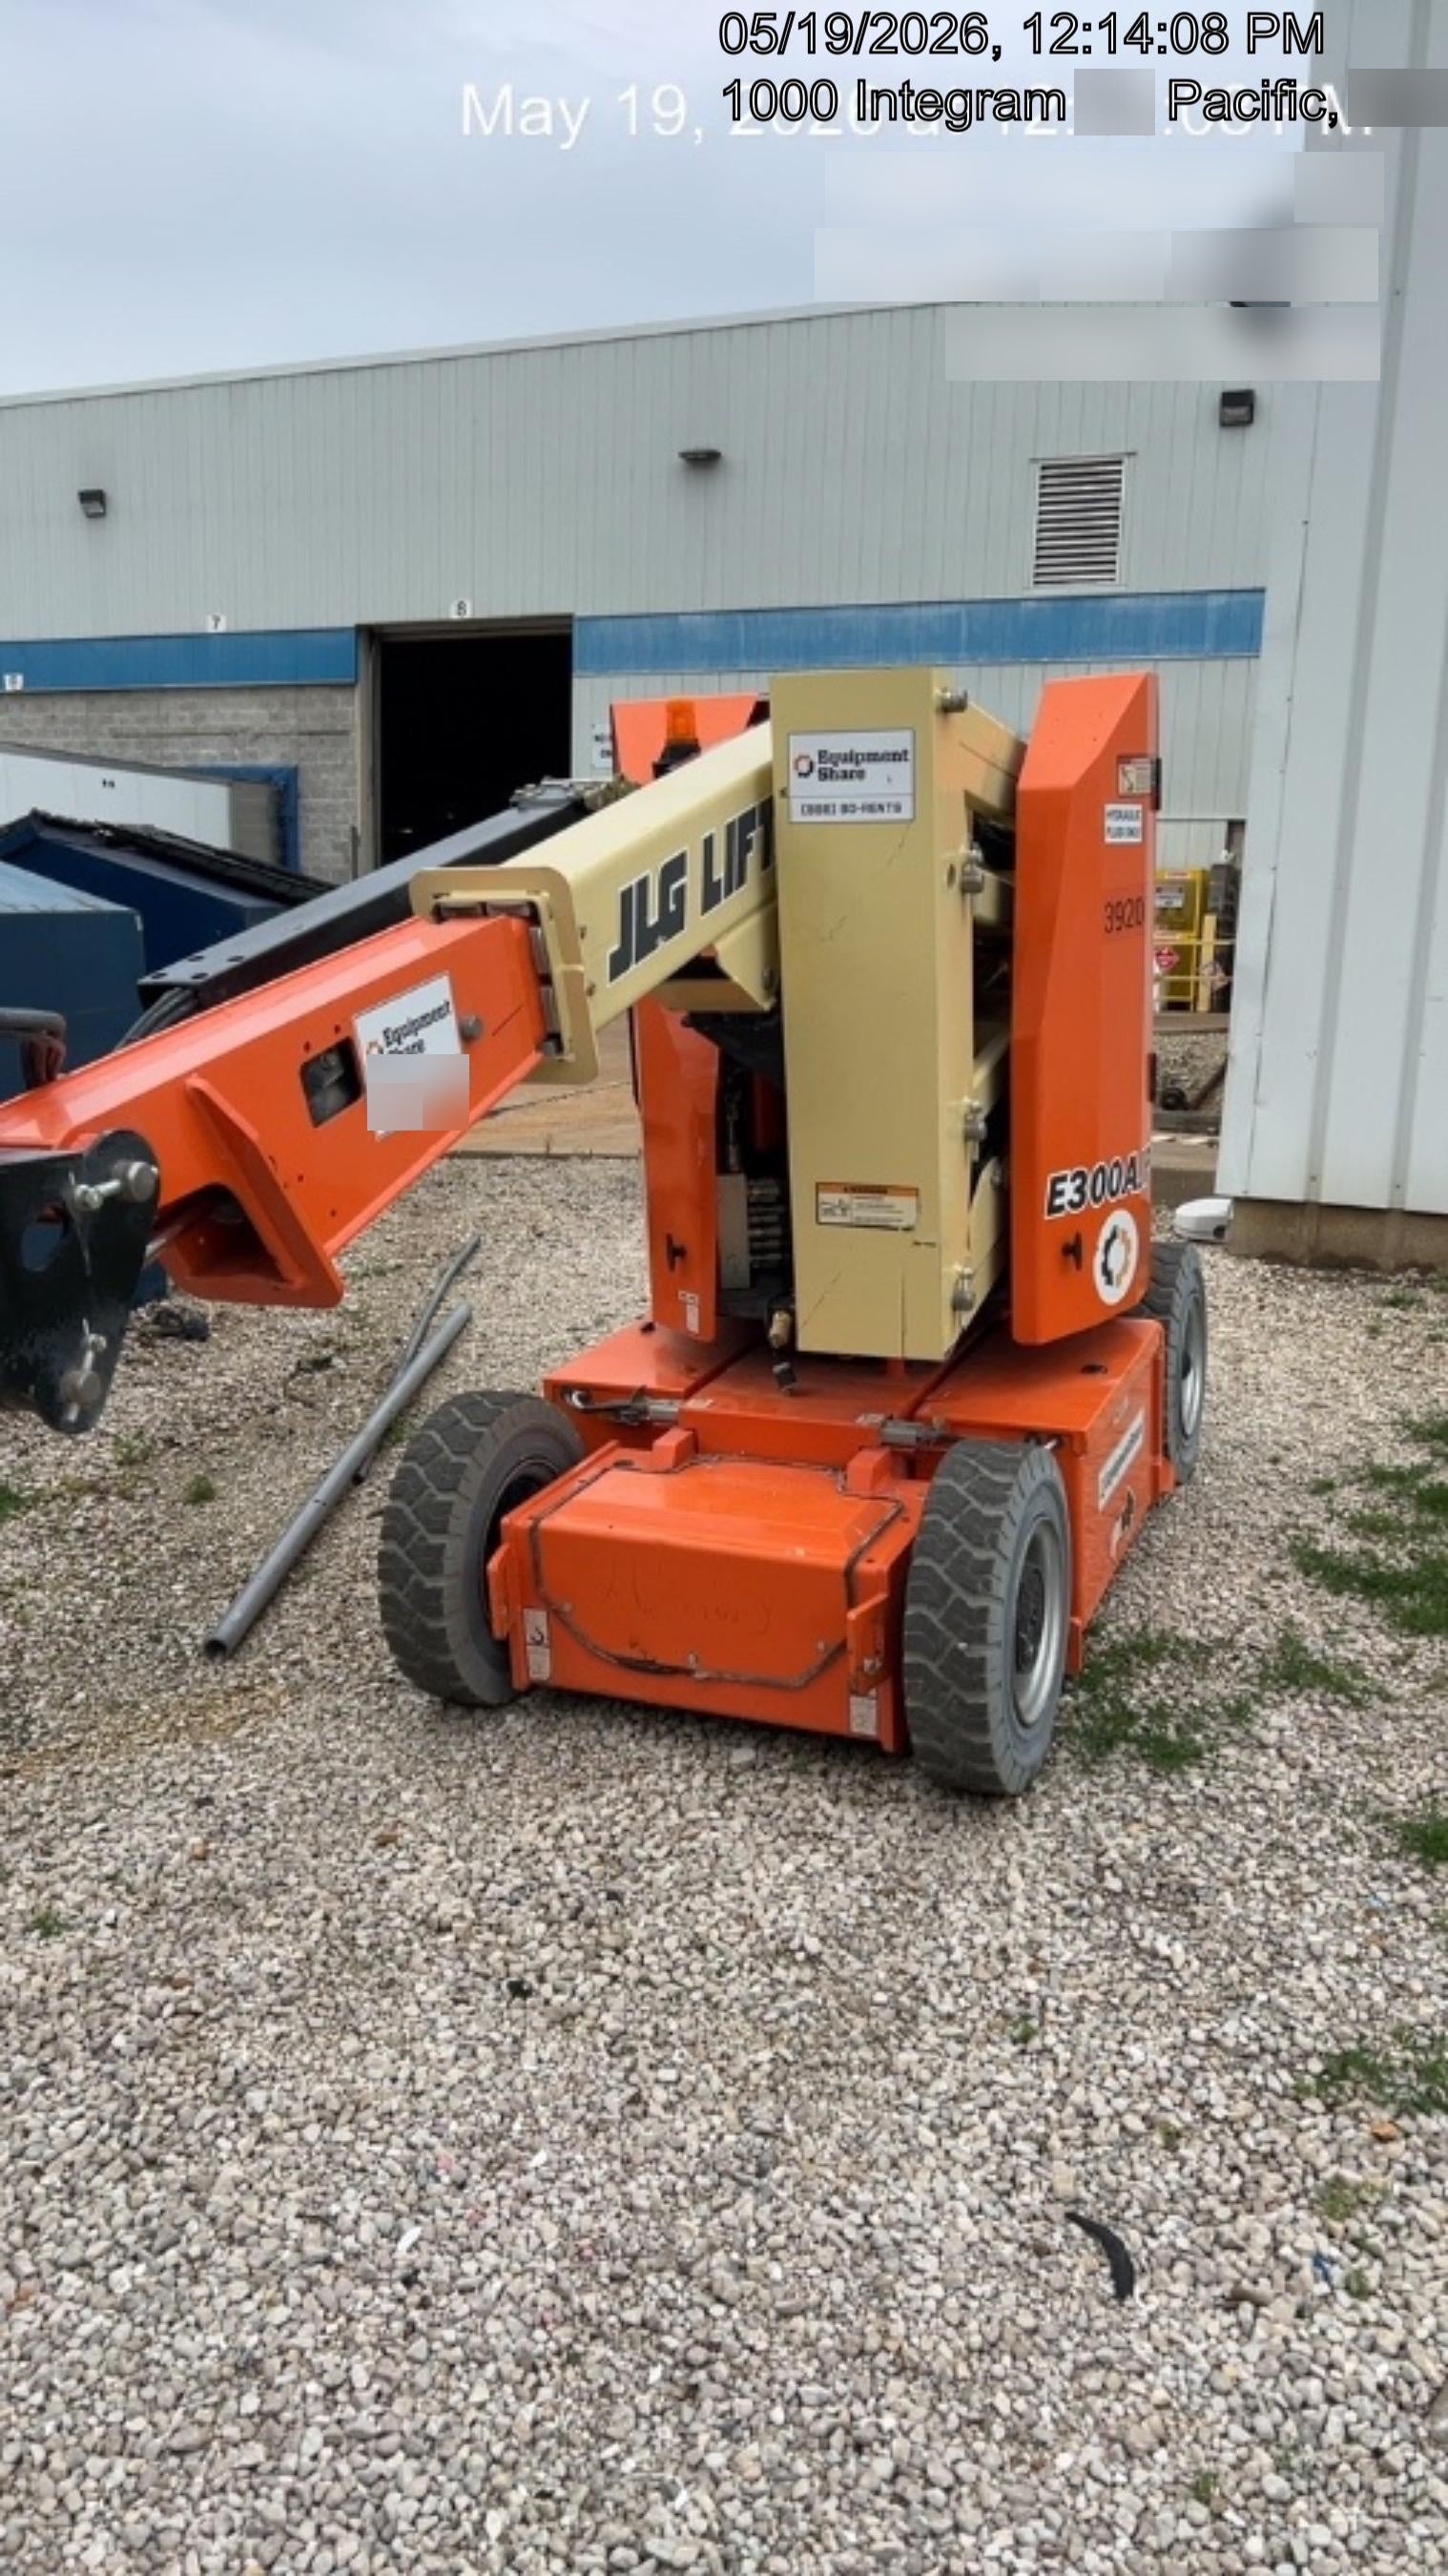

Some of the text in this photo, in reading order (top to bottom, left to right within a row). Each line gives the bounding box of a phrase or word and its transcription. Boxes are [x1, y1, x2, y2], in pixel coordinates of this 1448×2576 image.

[817, 749, 909, 767] Equipment
[817, 767, 866, 782] Share
[607, 846, 689, 987] JLG
[383, 999, 450, 1048] Equipment
